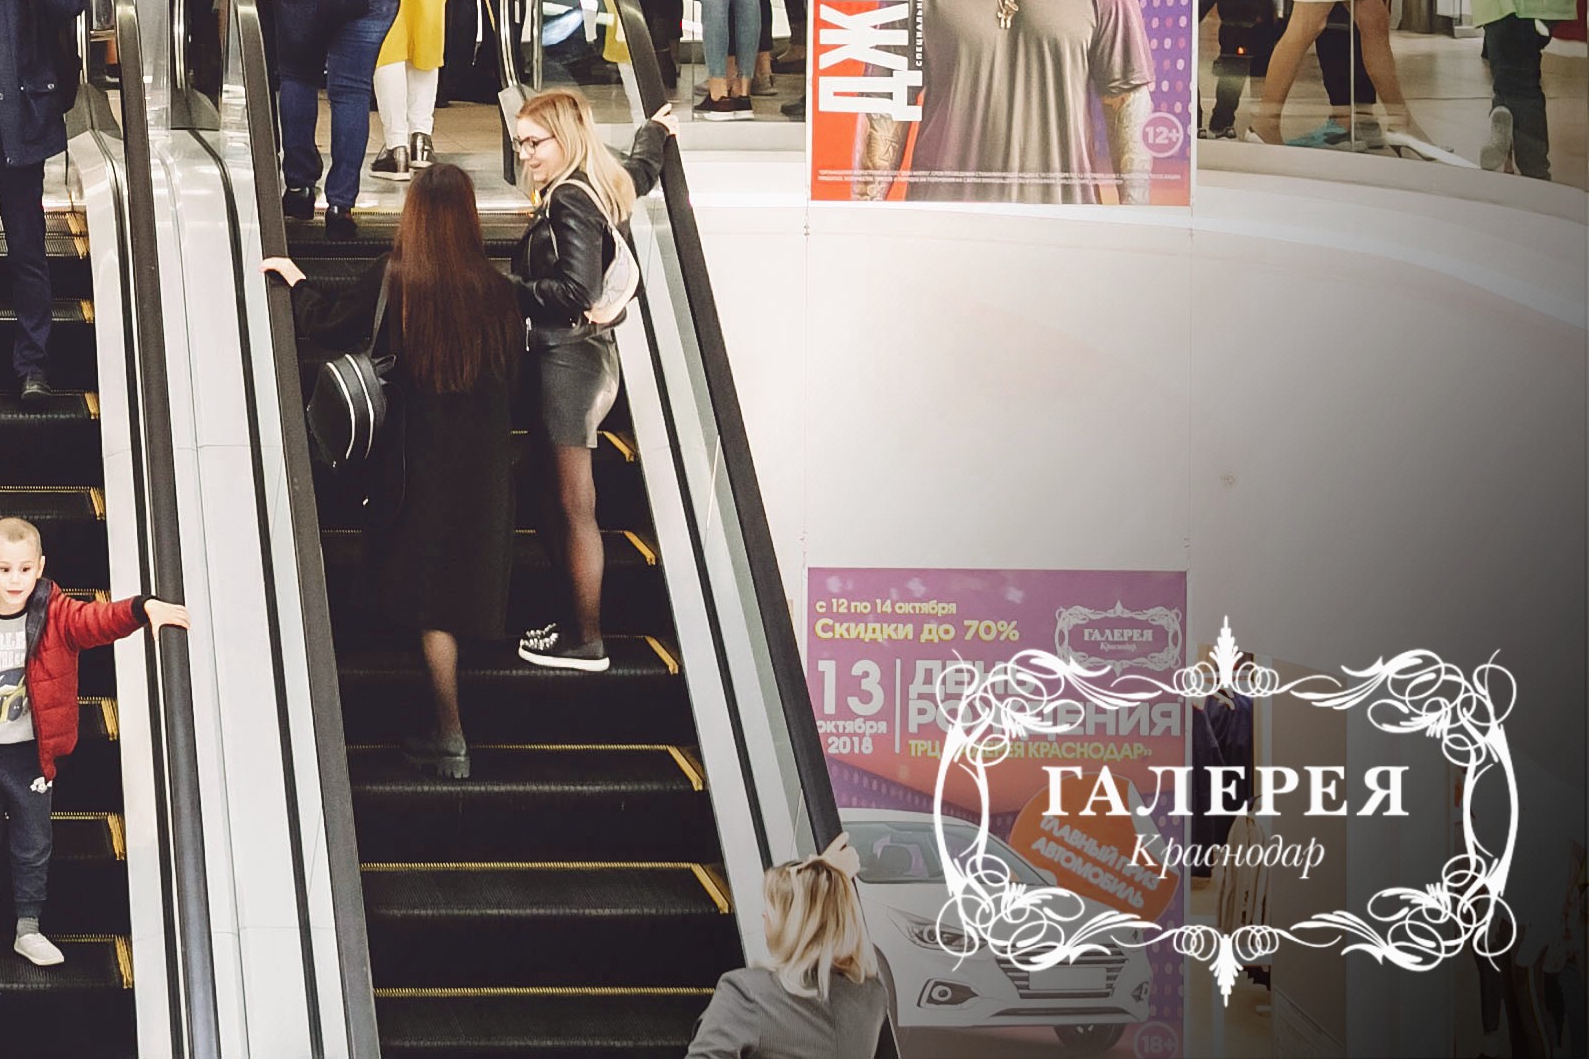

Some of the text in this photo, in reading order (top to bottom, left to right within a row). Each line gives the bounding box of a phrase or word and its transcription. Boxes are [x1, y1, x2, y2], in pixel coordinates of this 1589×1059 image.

[1145, 126, 1181, 145] 12+
[815, 599, 957, 616] с 12 по 14 октября
[815, 618, 1020, 643] Скидки до 70%
[1083, 628, 1153, 642] ГАЛЕРЕЯ
[818, 660, 885, 716] 13
[909, 660, 1036, 699] ДЕНЬ
[817, 717, 887, 735] октября
[828, 736, 873, 754] 2018
[908, 740, 941, 760] ТРЦ
[1028, 742, 1153, 761] КРАСНОДАР»
[1040, 815, 1160, 890] ГЛАВНЫЙ ПРИЗ
[1032, 837, 1145, 909] АВТОМОБИЛЬ
[1142, 1034, 1176, 1054] 18+
